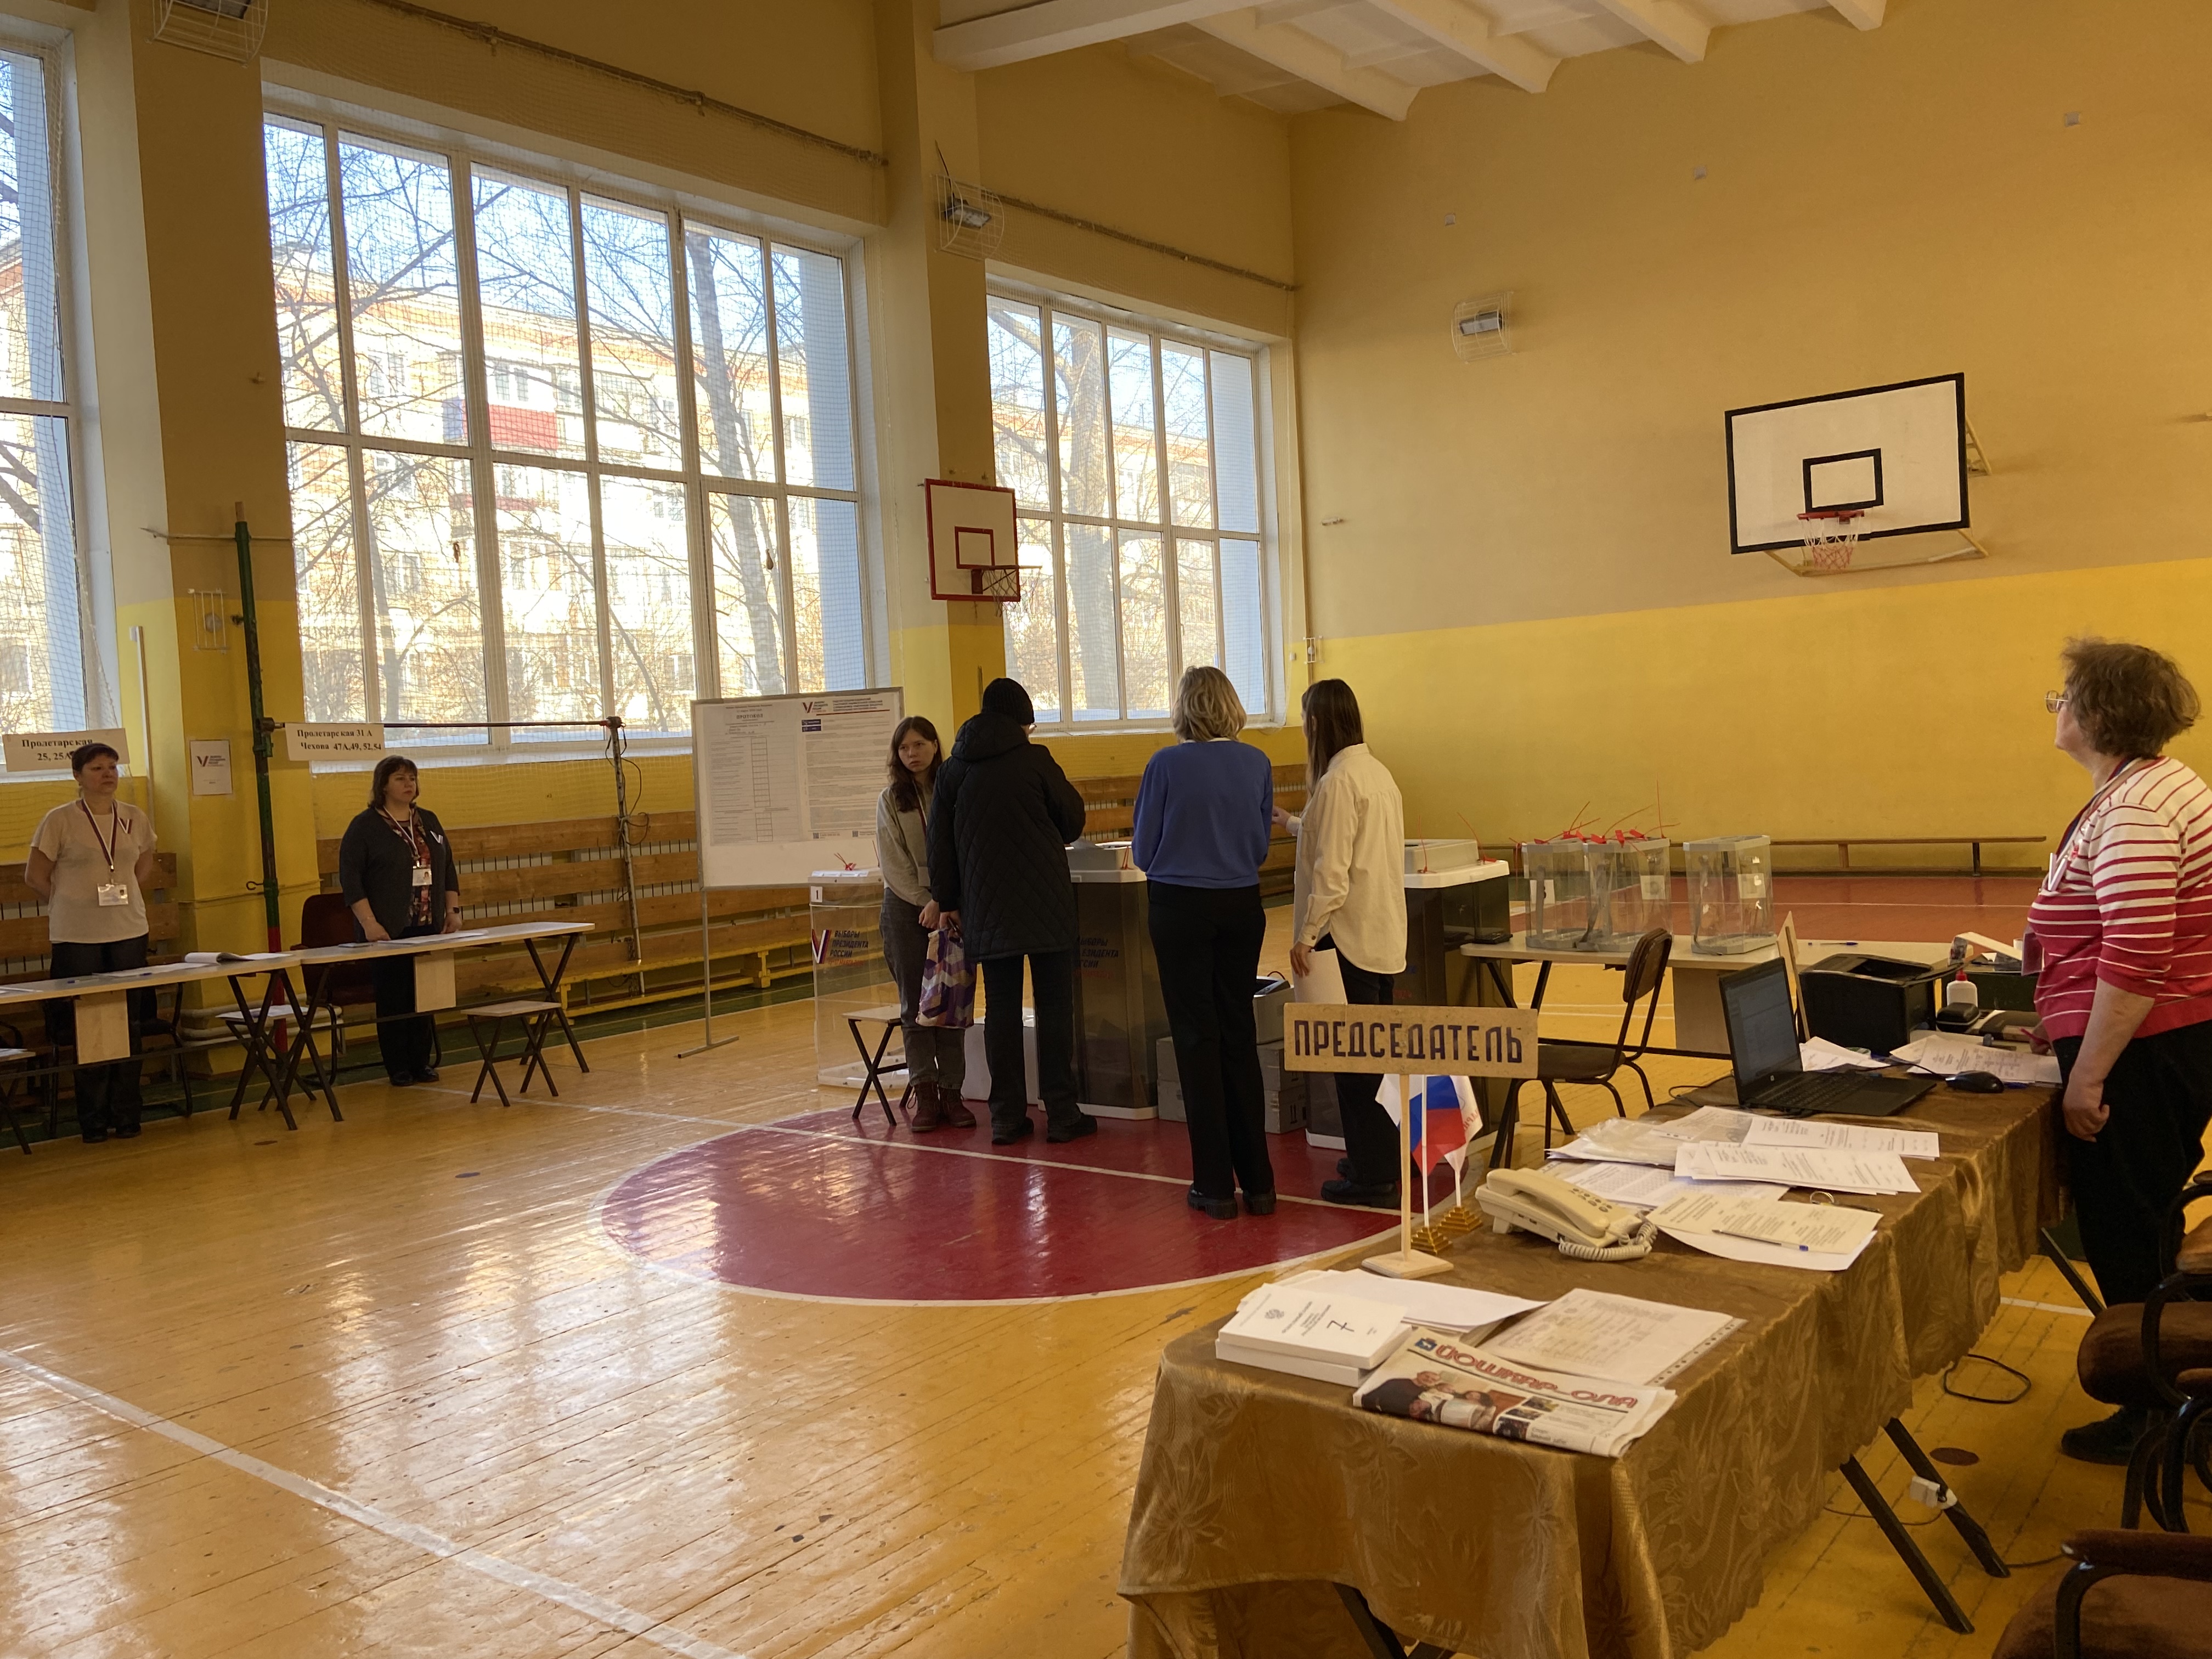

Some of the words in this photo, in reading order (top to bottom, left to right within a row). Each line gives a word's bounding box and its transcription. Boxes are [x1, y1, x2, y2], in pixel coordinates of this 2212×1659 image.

[297, 730, 354, 739] Пролетарская
[301, 742, 329, 750] Чехова
[37, 753, 51, 761] 25,
[816, 890, 819, 900] 1
[834, 930, 860, 938] ВЫБОРЫ
[832, 940, 869, 949] ПРЕЗИДЕНТА
[1077, 938, 1108, 946] ЫБОРЫ
[830, 950, 853, 958] РОССИИ
[1081, 949, 1119, 958] ЕЗИДЕНТА
[1294, 1020, 1522, 1063] ПРЕДСЕДАТЕЛЬ
